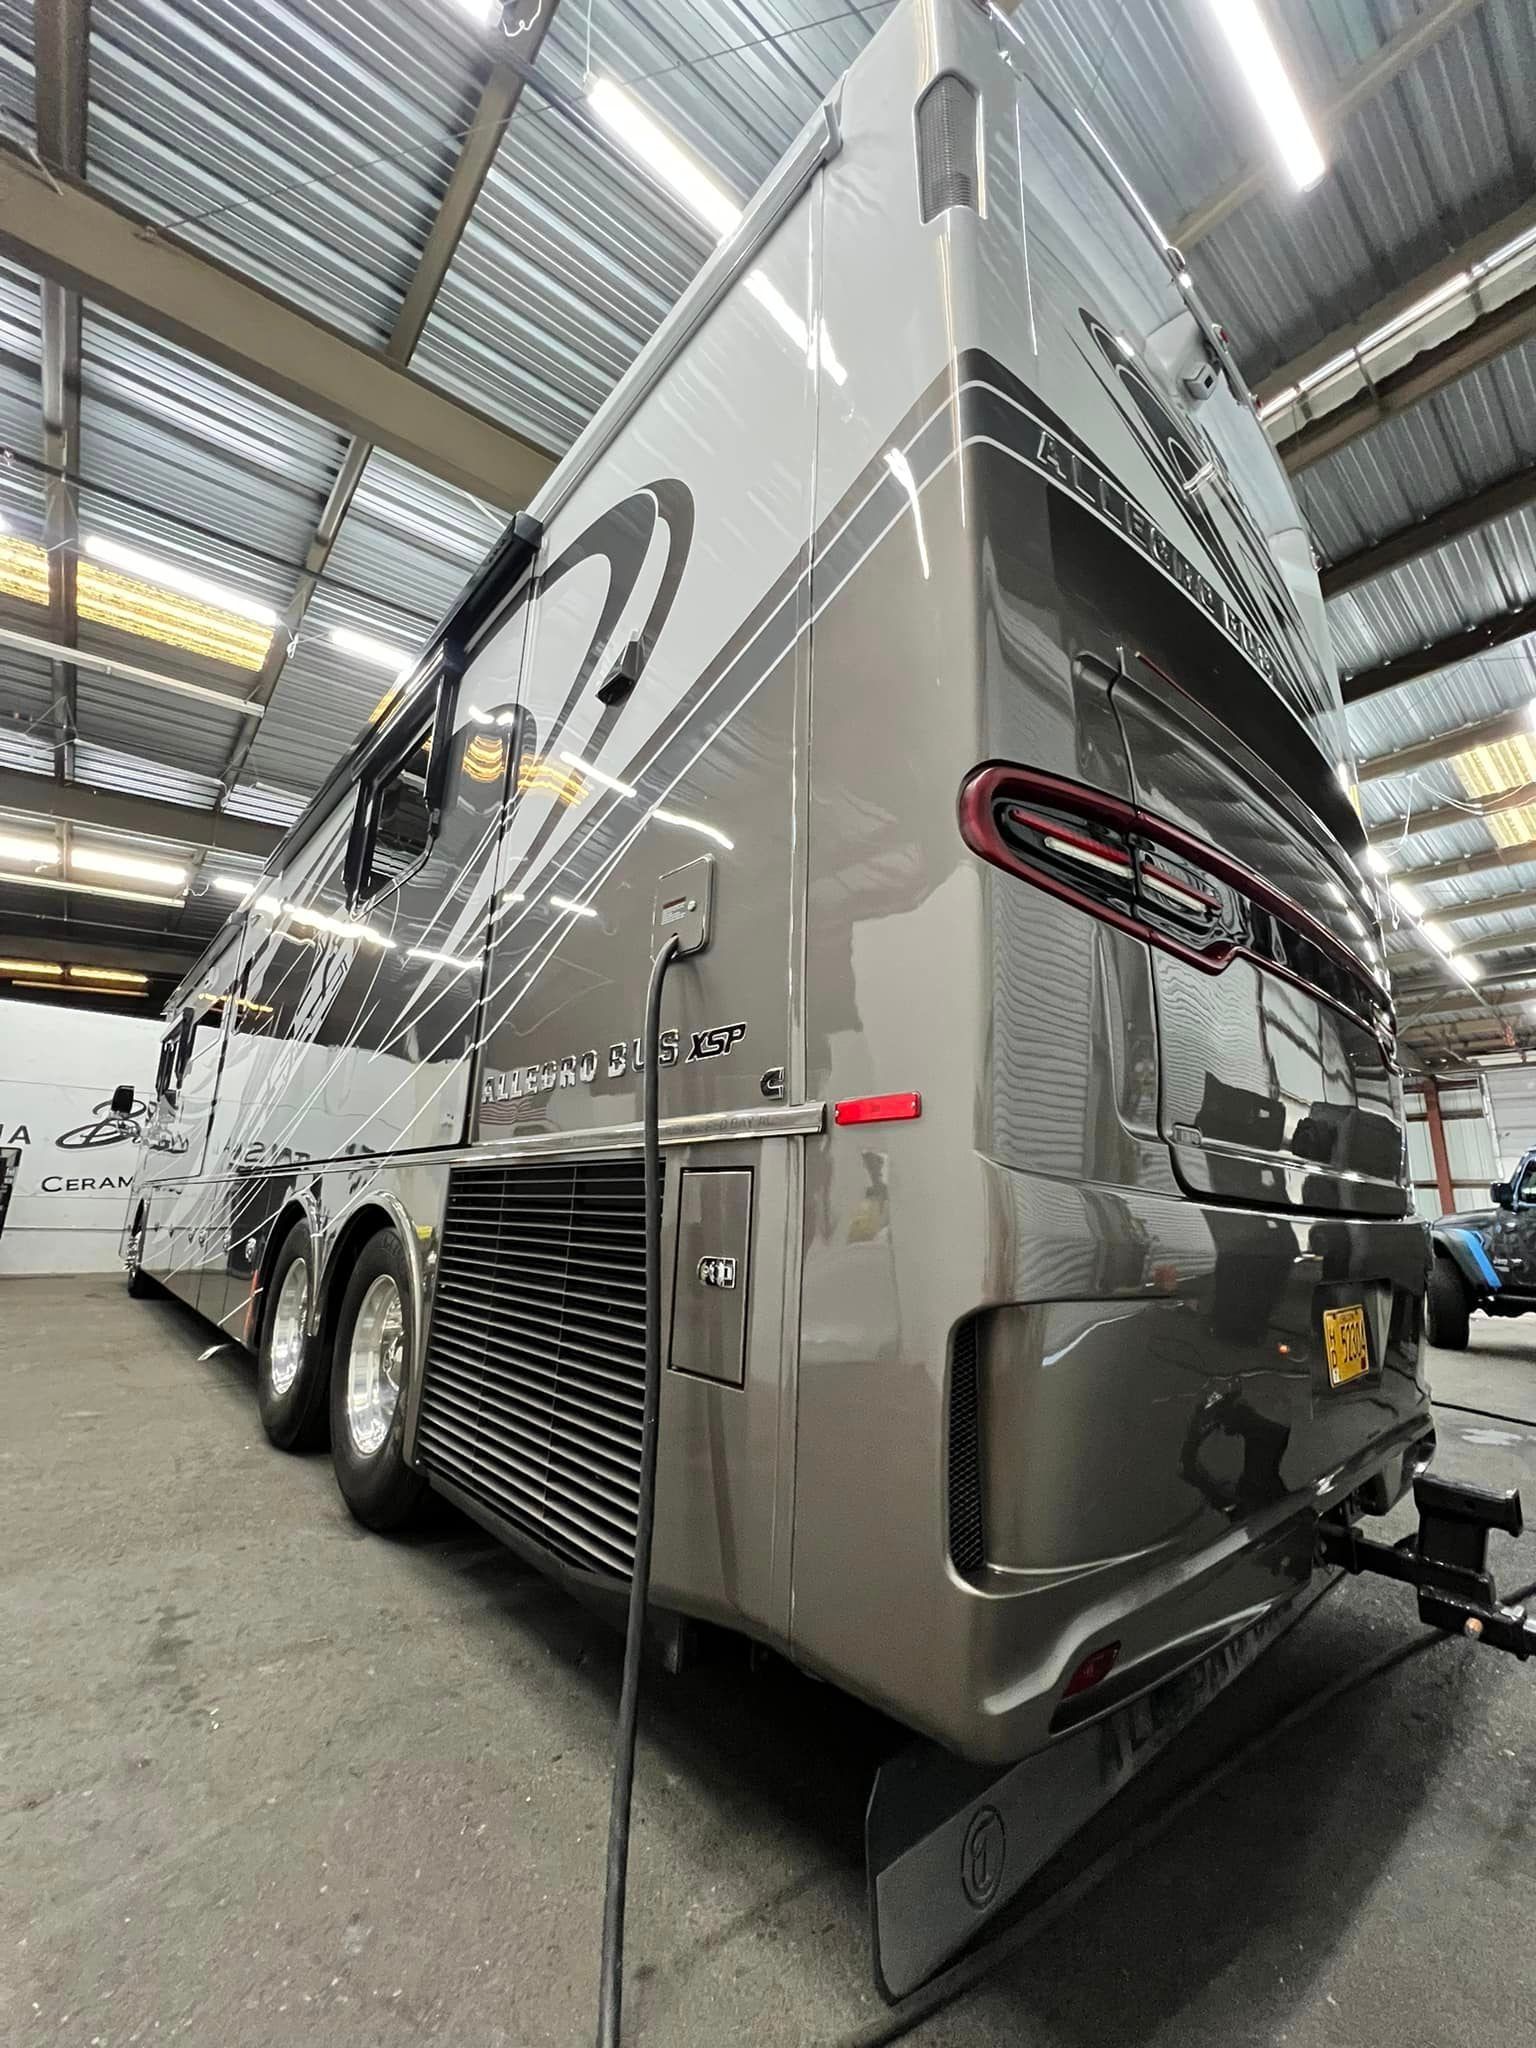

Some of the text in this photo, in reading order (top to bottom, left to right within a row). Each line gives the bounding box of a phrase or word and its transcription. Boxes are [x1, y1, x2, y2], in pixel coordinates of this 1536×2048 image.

[481, 1022, 748, 1103] ALLEGRO BUS XSP
